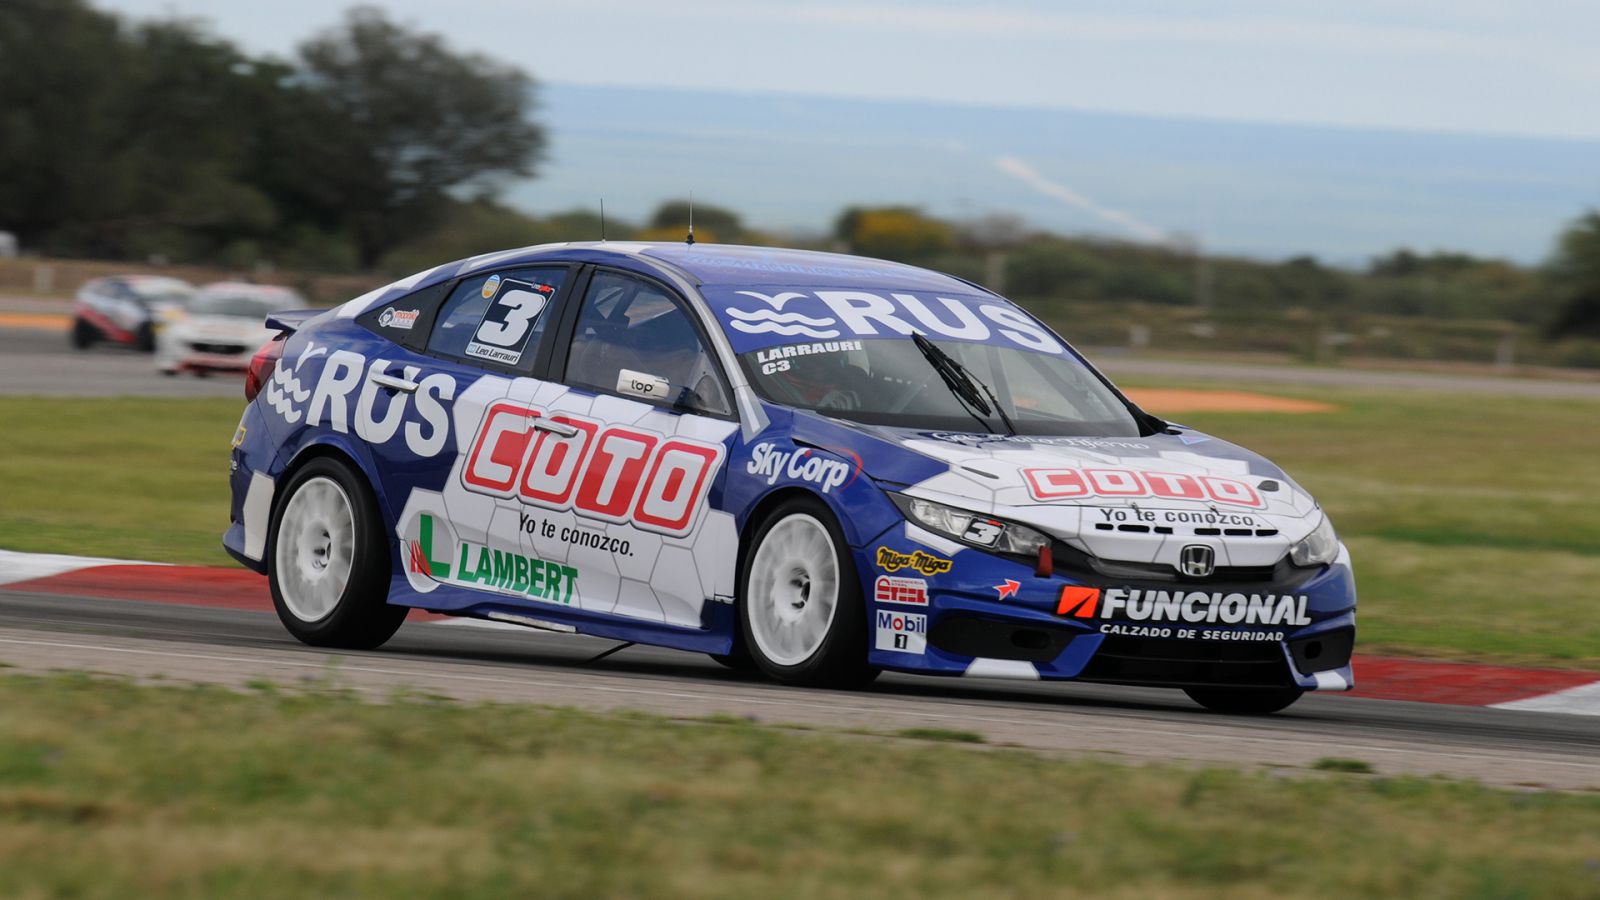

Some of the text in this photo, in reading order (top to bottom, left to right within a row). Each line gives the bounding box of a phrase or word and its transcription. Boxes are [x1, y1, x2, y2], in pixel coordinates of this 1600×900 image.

[477, 289, 546, 347] 3
[813, 291, 1063, 355] RUS
[475, 344, 520, 363] Leo Larrauri
[757, 341, 862, 363] LARRAURI
[762, 360, 791, 375] C3
[306, 349, 457, 458] RUS
[467, 404, 715, 529] COTO
[746, 442, 849, 493] Sky Corp
[1026, 468, 1257, 505] COTO
[520, 513, 634, 557] Yo te conozco.
[963, 521, 1002, 544] 3
[1100, 508, 1262, 528] Yo te conozco.
[456, 543, 578, 605] LAMBERT
[878, 612, 925, 633] Mobil
[1100, 588, 1312, 625] FUNCIONAL
[1100, 623, 1284, 641] CALZADO DE SEGURIDAD
